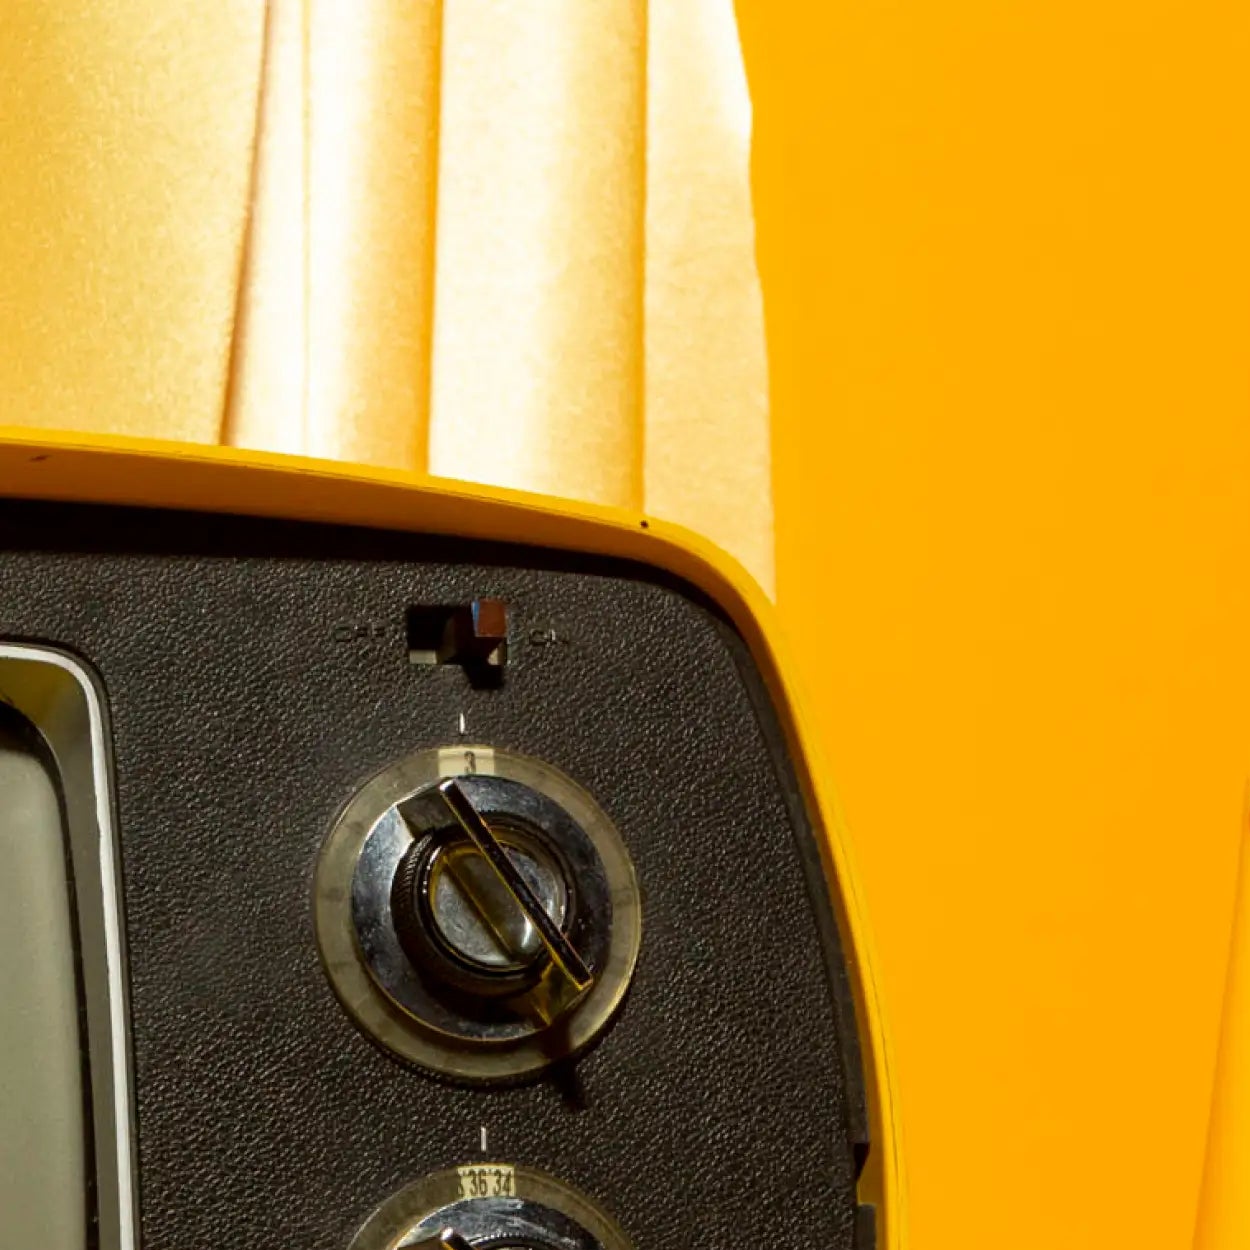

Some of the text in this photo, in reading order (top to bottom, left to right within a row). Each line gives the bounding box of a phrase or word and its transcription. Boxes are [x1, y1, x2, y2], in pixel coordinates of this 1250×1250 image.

[464, 751, 476, 774] 3
[469, 1169, 488, 1197] 36
[492, 1169, 512, 1197] 34
